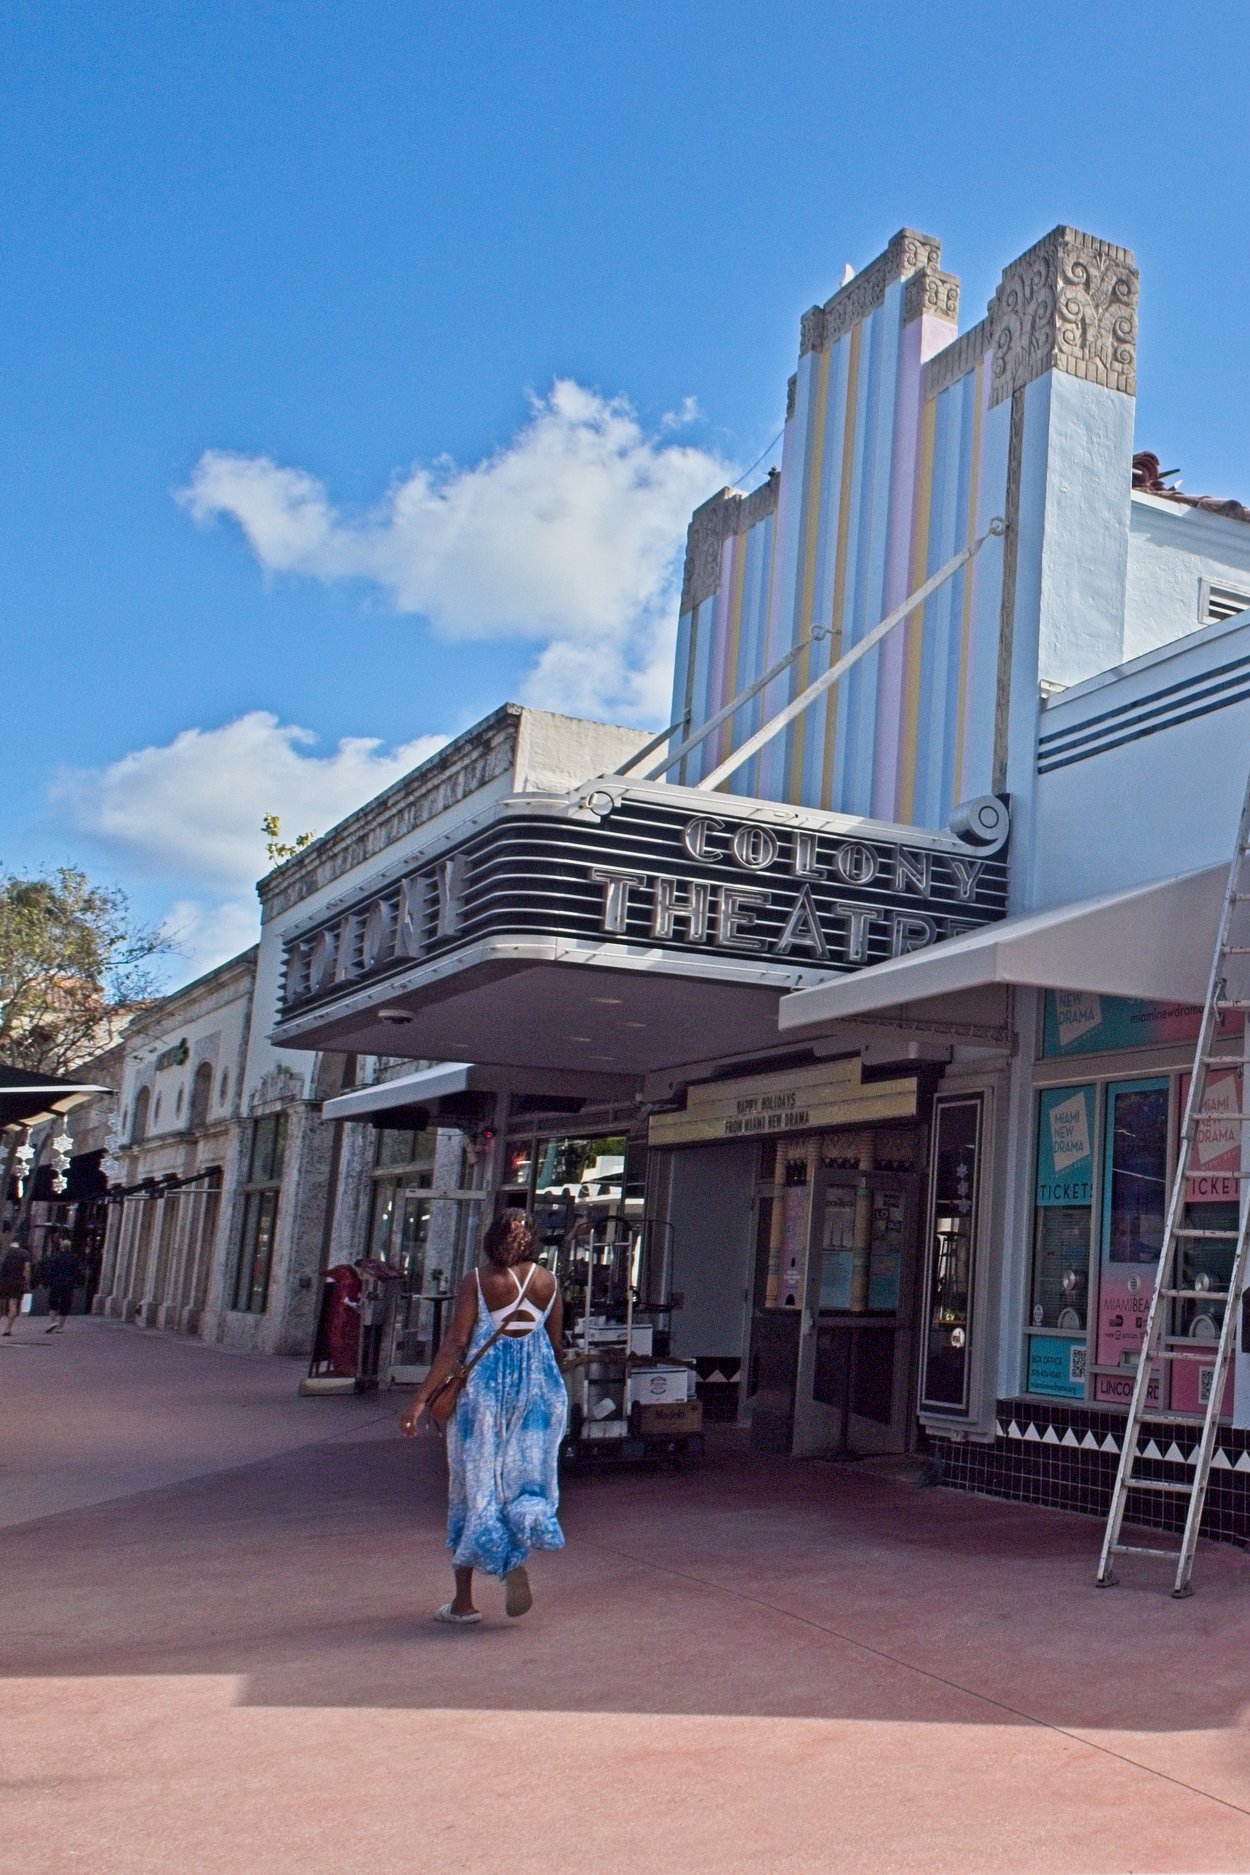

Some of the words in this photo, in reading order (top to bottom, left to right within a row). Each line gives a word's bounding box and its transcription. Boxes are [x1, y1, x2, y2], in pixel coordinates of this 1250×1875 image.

[683, 815, 986, 900] COLONY
[1058, 1008, 1095, 1026] DRAMA
[1130, 1003, 1204, 1024] miaminewdrama
[736, 1098, 758, 1114] HAPPY
[760, 1092, 796, 1111] HOLIDAYS
[724, 1119, 743, 1135] FROM
[744, 1115, 766, 1133] MIAMI
[767, 1113, 782, 1129] NEW
[784, 1110, 809, 1127] DRAMA
[1054, 1125, 1074, 1139] NEW
[1197, 1128, 1235, 1143] DRAMA
[1053, 1140, 1084, 1153] DRAMA
[1103, 1298, 1149, 1313] MIAMIBEA
[1043, 1355, 1063, 1366] OFFICE
[1100, 1380, 1135, 1397] LINCOL
